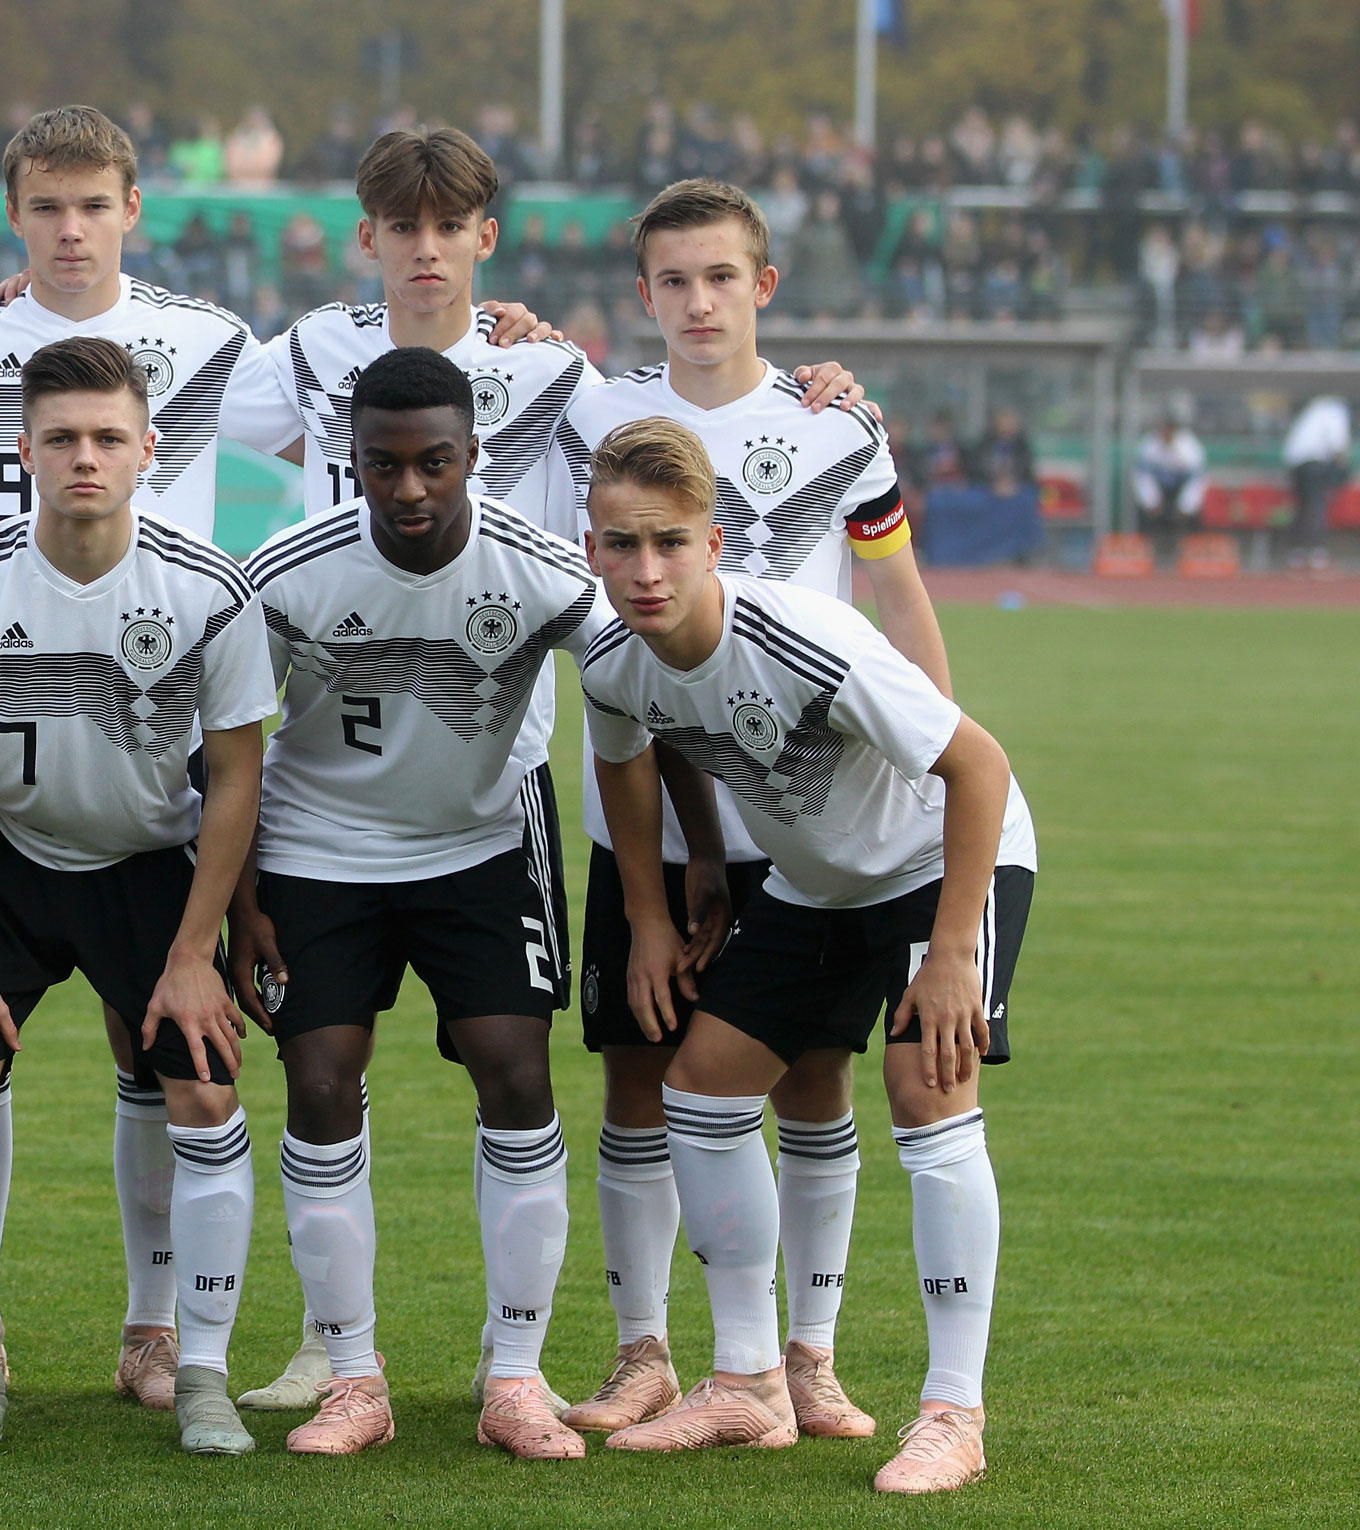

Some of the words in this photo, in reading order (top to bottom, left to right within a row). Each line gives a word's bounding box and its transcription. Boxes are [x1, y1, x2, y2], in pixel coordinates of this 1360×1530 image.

[338, 380, 354, 390] adi
[332, 626, 373, 637] adidas
[341, 694, 383, 757] 2
[521, 916, 554, 994] 2
[152, 1251, 173, 1265] DF
[195, 1274, 235, 1292] DFB
[811, 1273, 844, 1287] DFB
[923, 1276, 968, 1295] DFB
[502, 1304, 537, 1321] DFB
[314, 1319, 342, 1335] DFB
